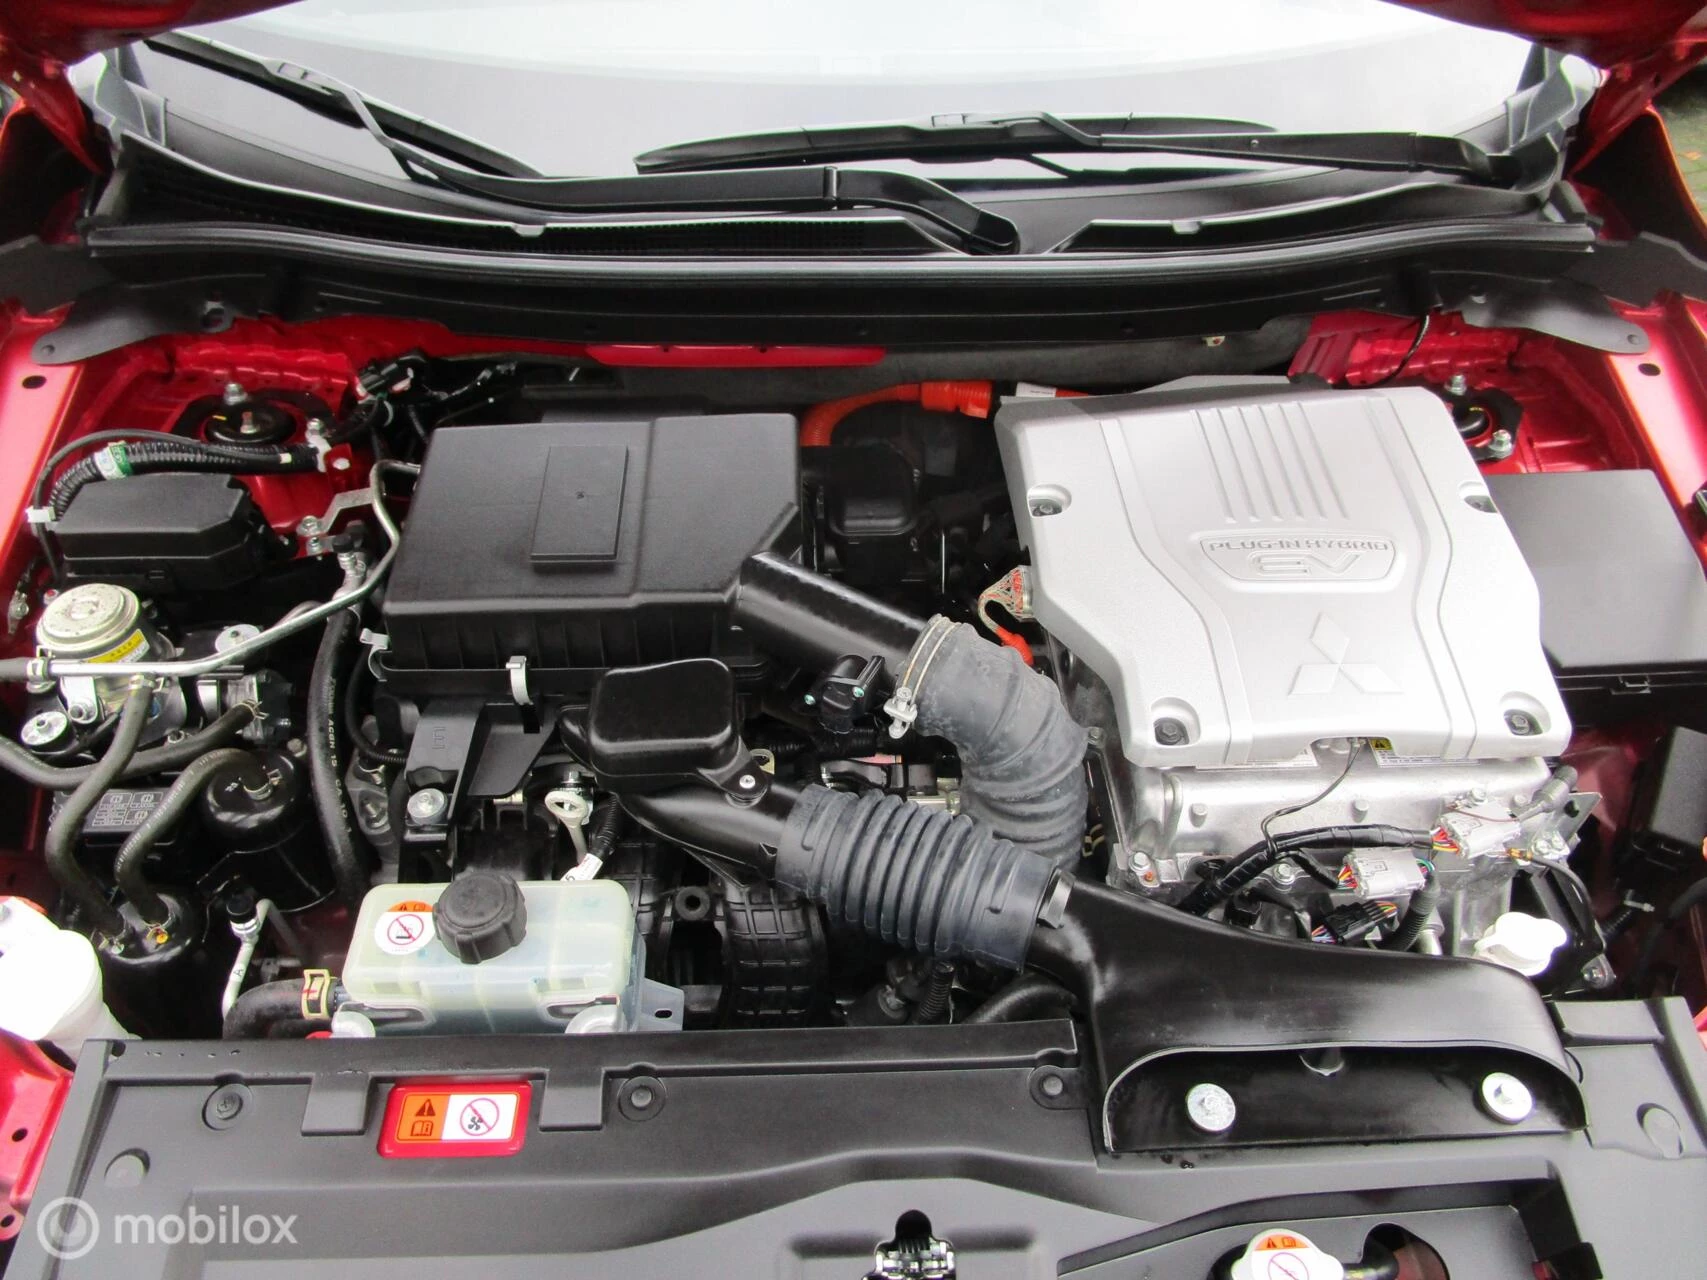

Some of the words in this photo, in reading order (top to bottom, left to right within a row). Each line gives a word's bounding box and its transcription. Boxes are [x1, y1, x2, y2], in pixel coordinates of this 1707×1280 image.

[1208, 540, 1301, 551] PLUG-IN
[1305, 540, 1390, 551] HYBRID
[1249, 551, 1364, 576] EV
